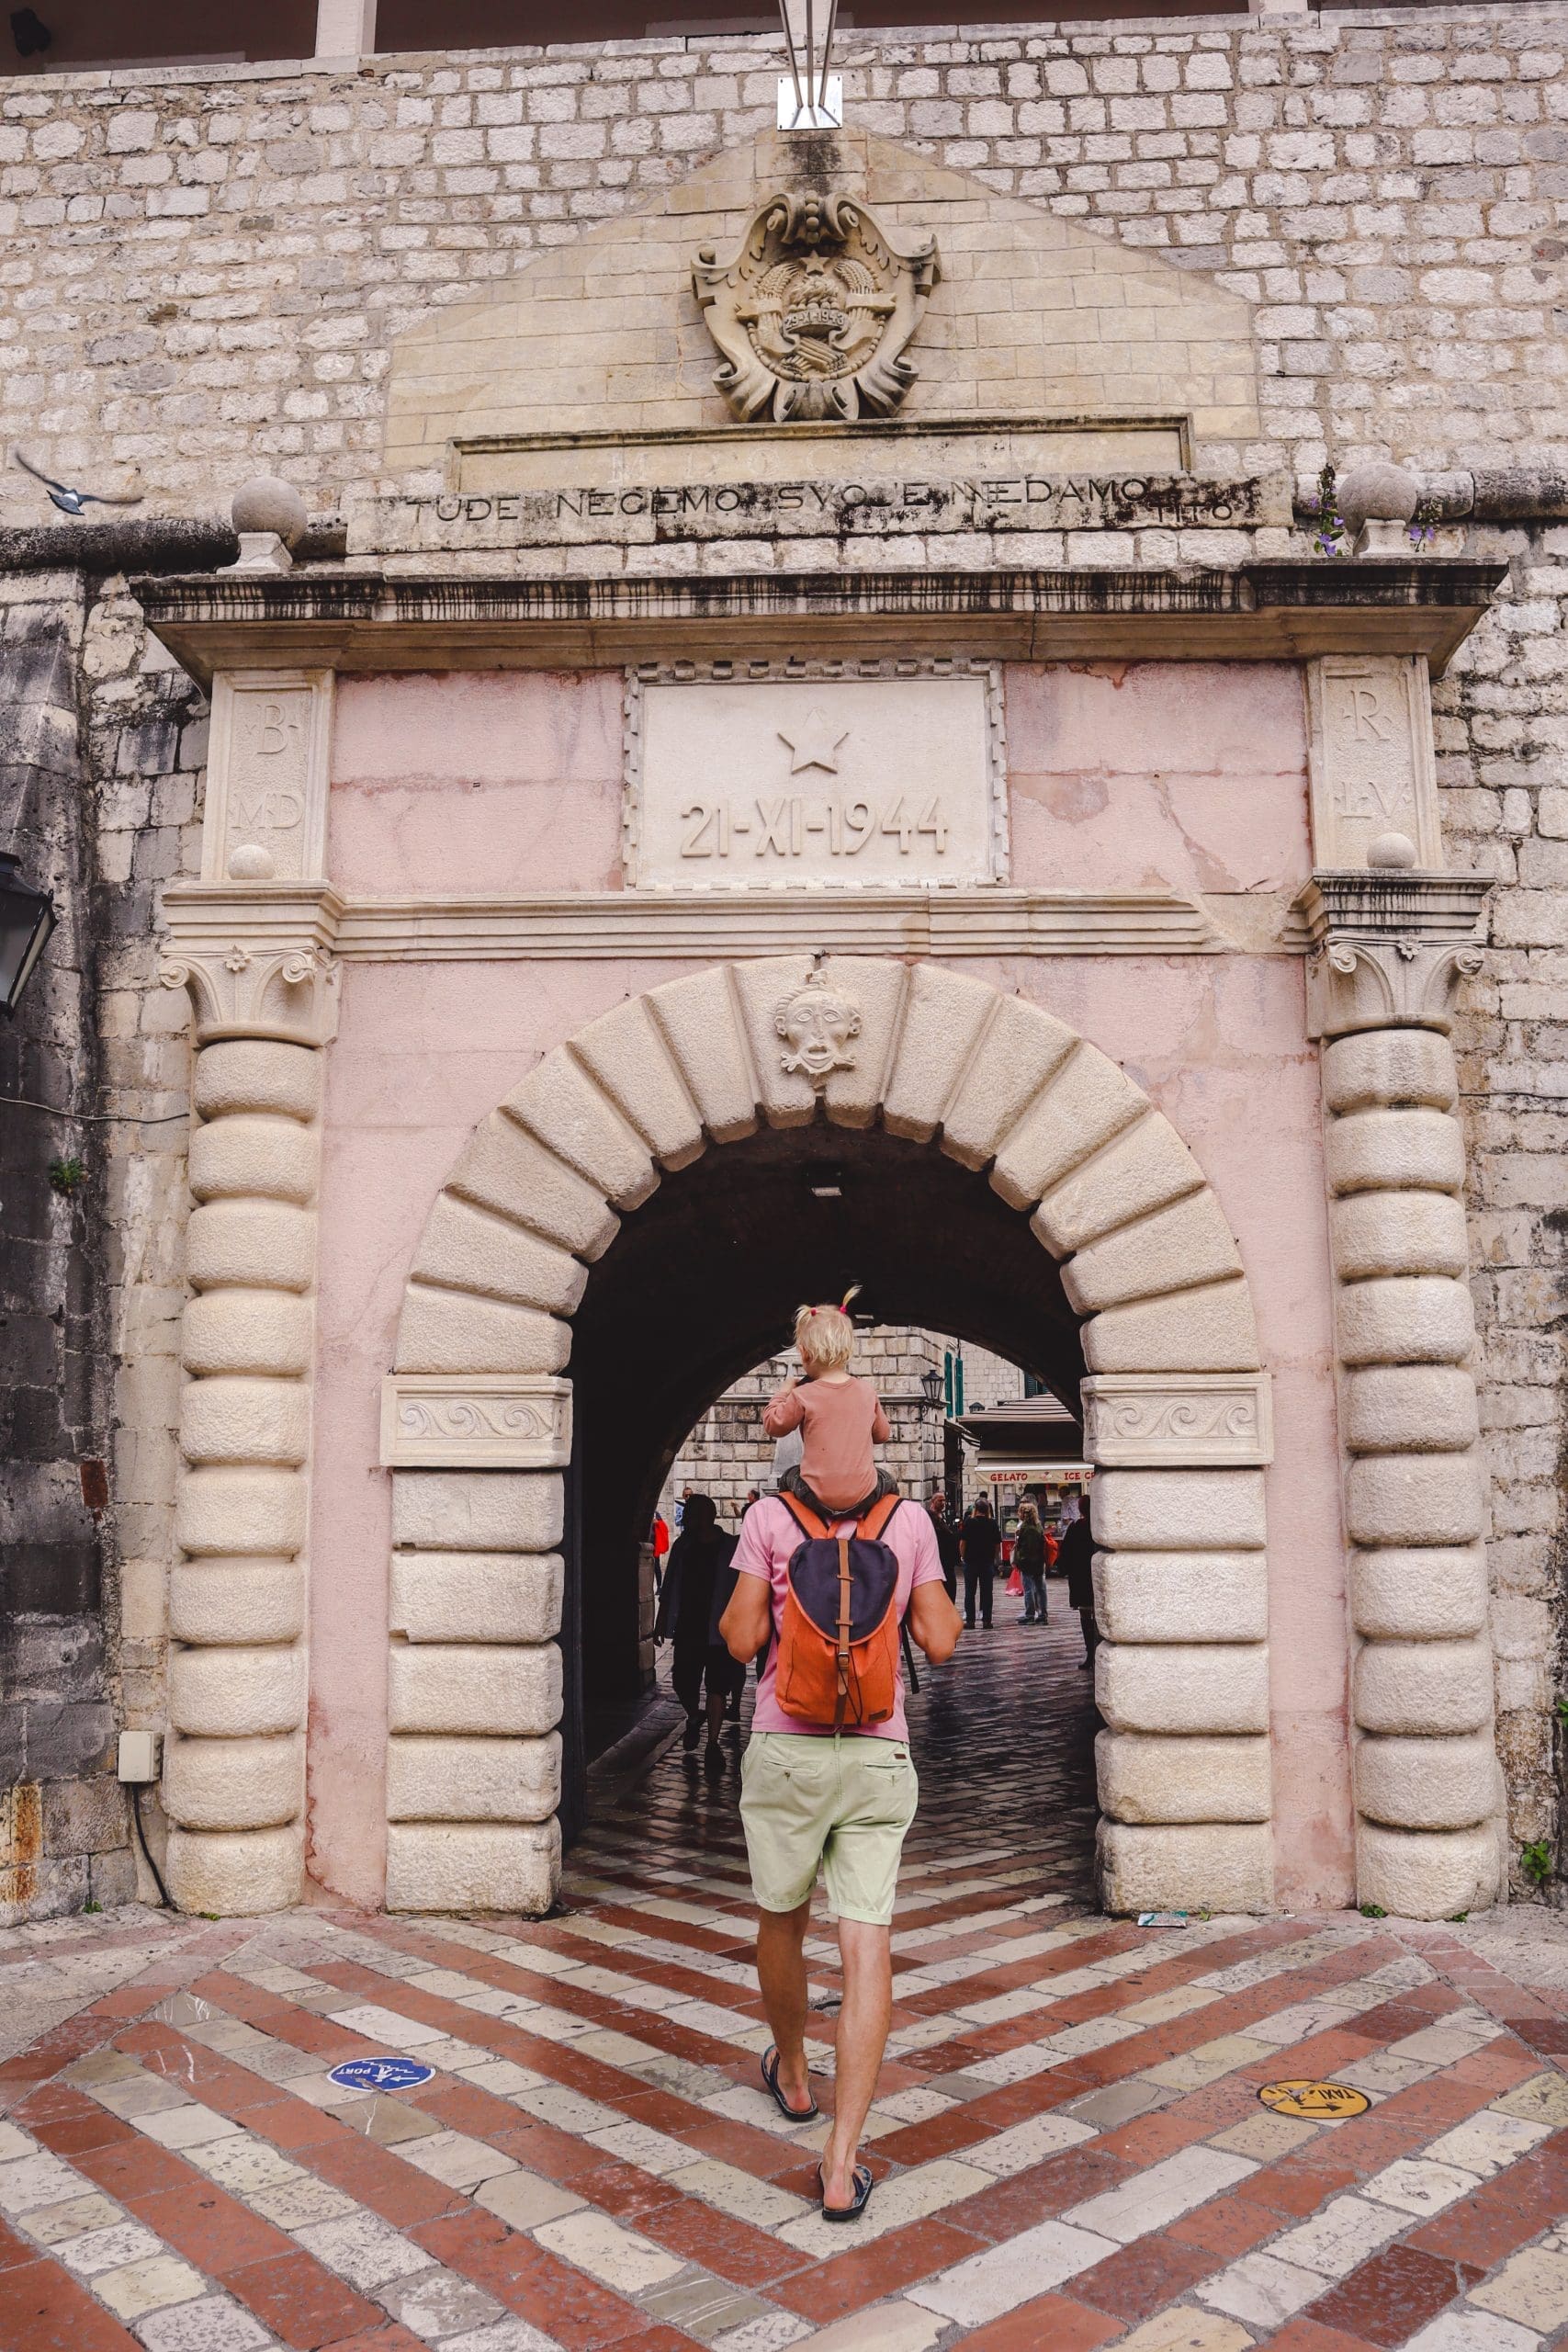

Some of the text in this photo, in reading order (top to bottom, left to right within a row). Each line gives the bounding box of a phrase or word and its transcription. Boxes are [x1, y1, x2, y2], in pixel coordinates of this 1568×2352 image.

[682, 796, 948, 857] 21-XI-1944
[990, 1473, 1028, 1482] GELATO
[1065, 1472, 1081, 1480] ICE
[337, 2067, 372, 2075] PORT
[1318, 2088, 1356, 2099] TAXI
